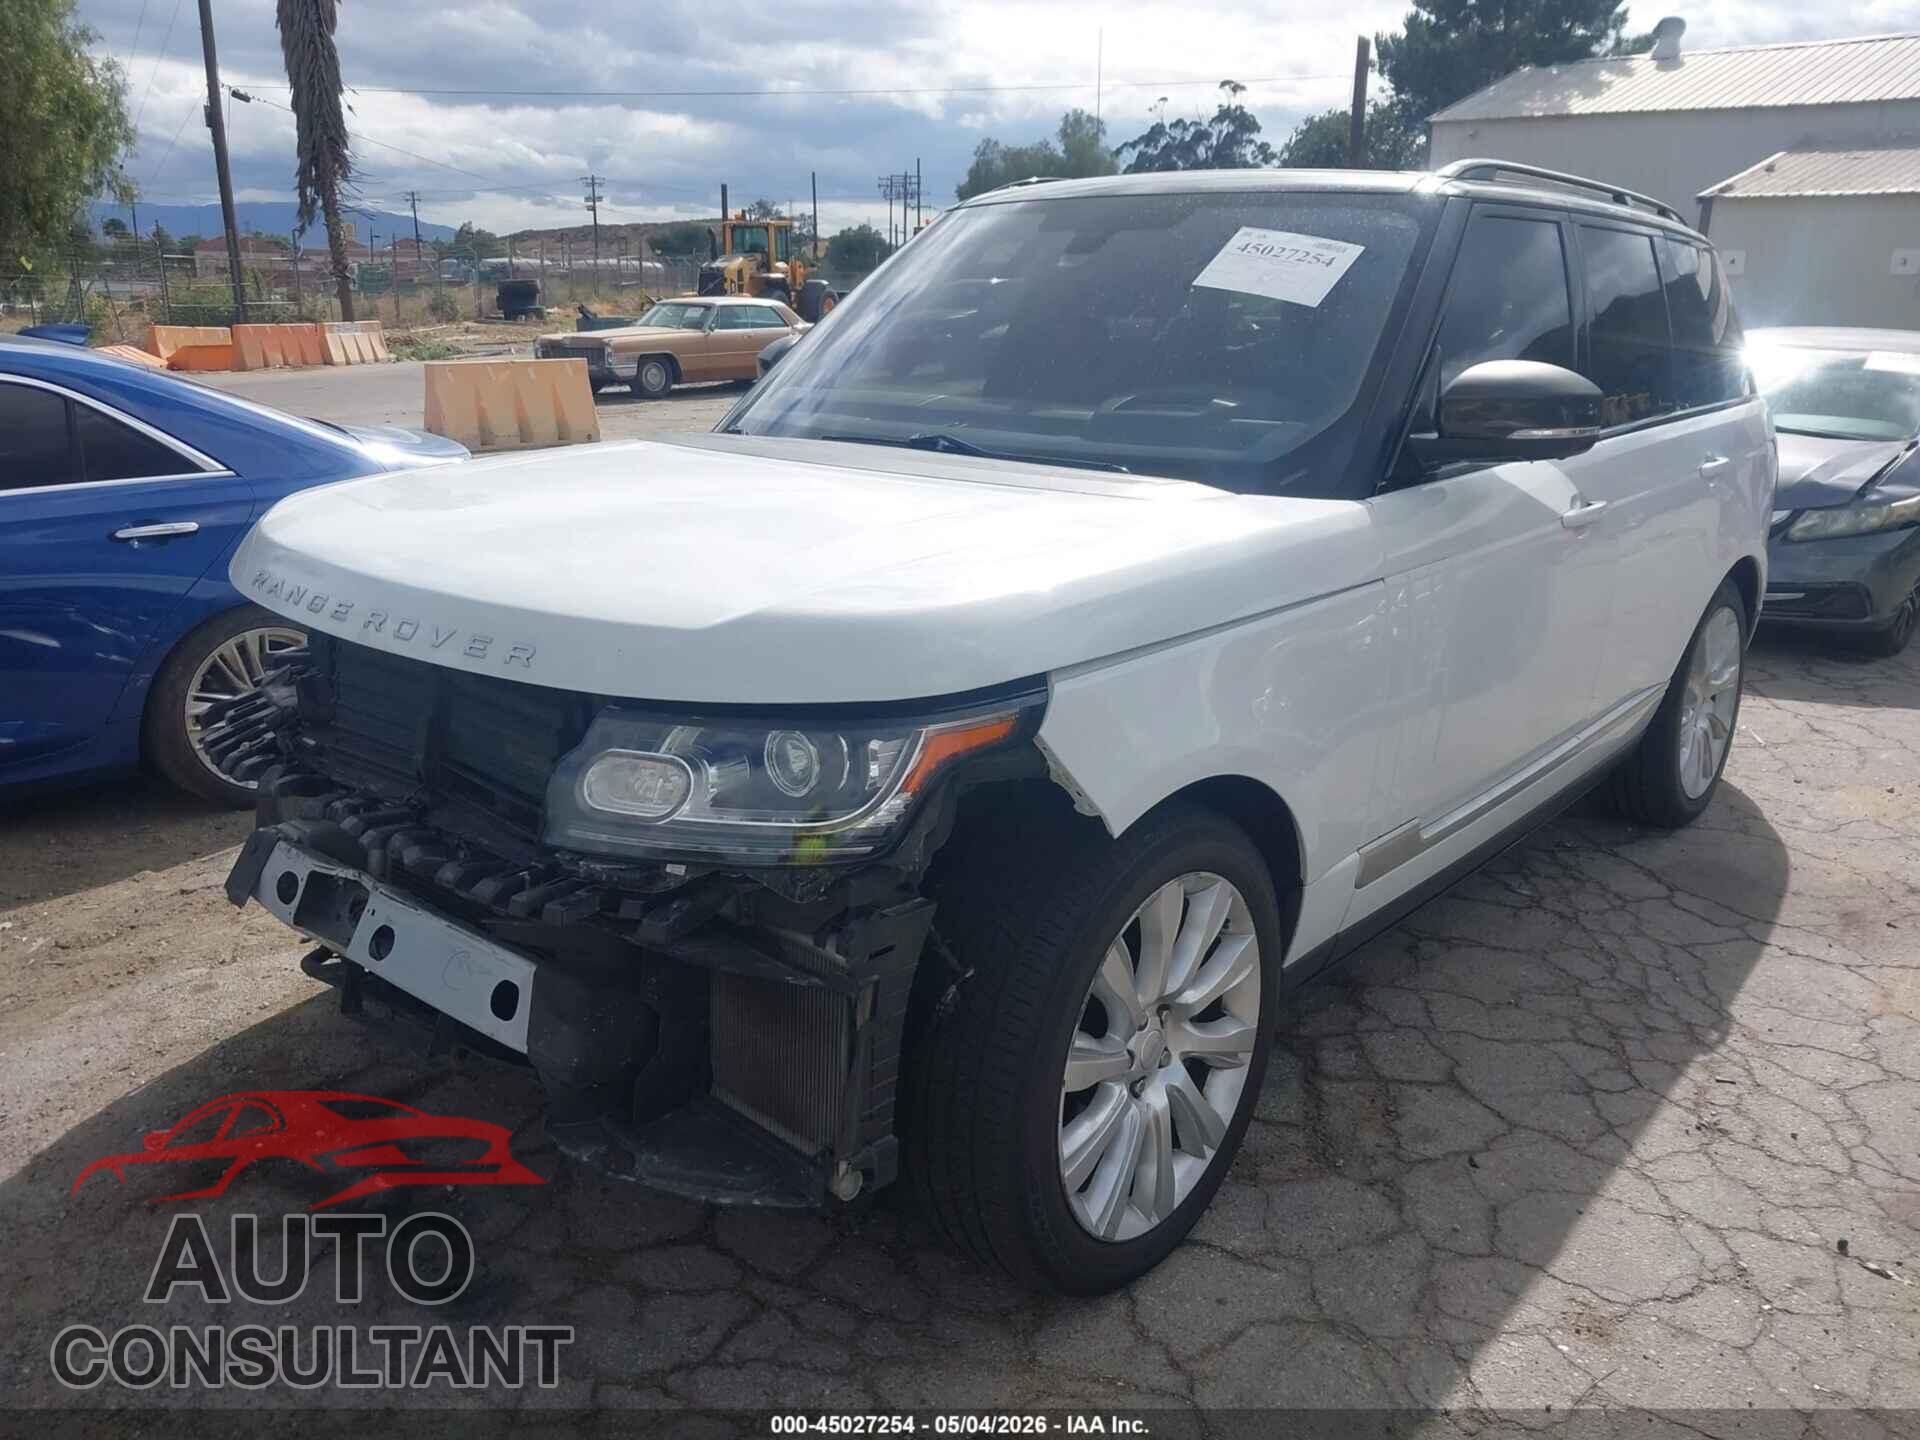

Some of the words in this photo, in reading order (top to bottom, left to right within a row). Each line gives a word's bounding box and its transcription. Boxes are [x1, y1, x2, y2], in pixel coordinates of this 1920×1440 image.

[1236, 242, 1337, 268] 45027254
[252, 569, 354, 622] RANGE
[363, 609, 537, 668] ROVER
